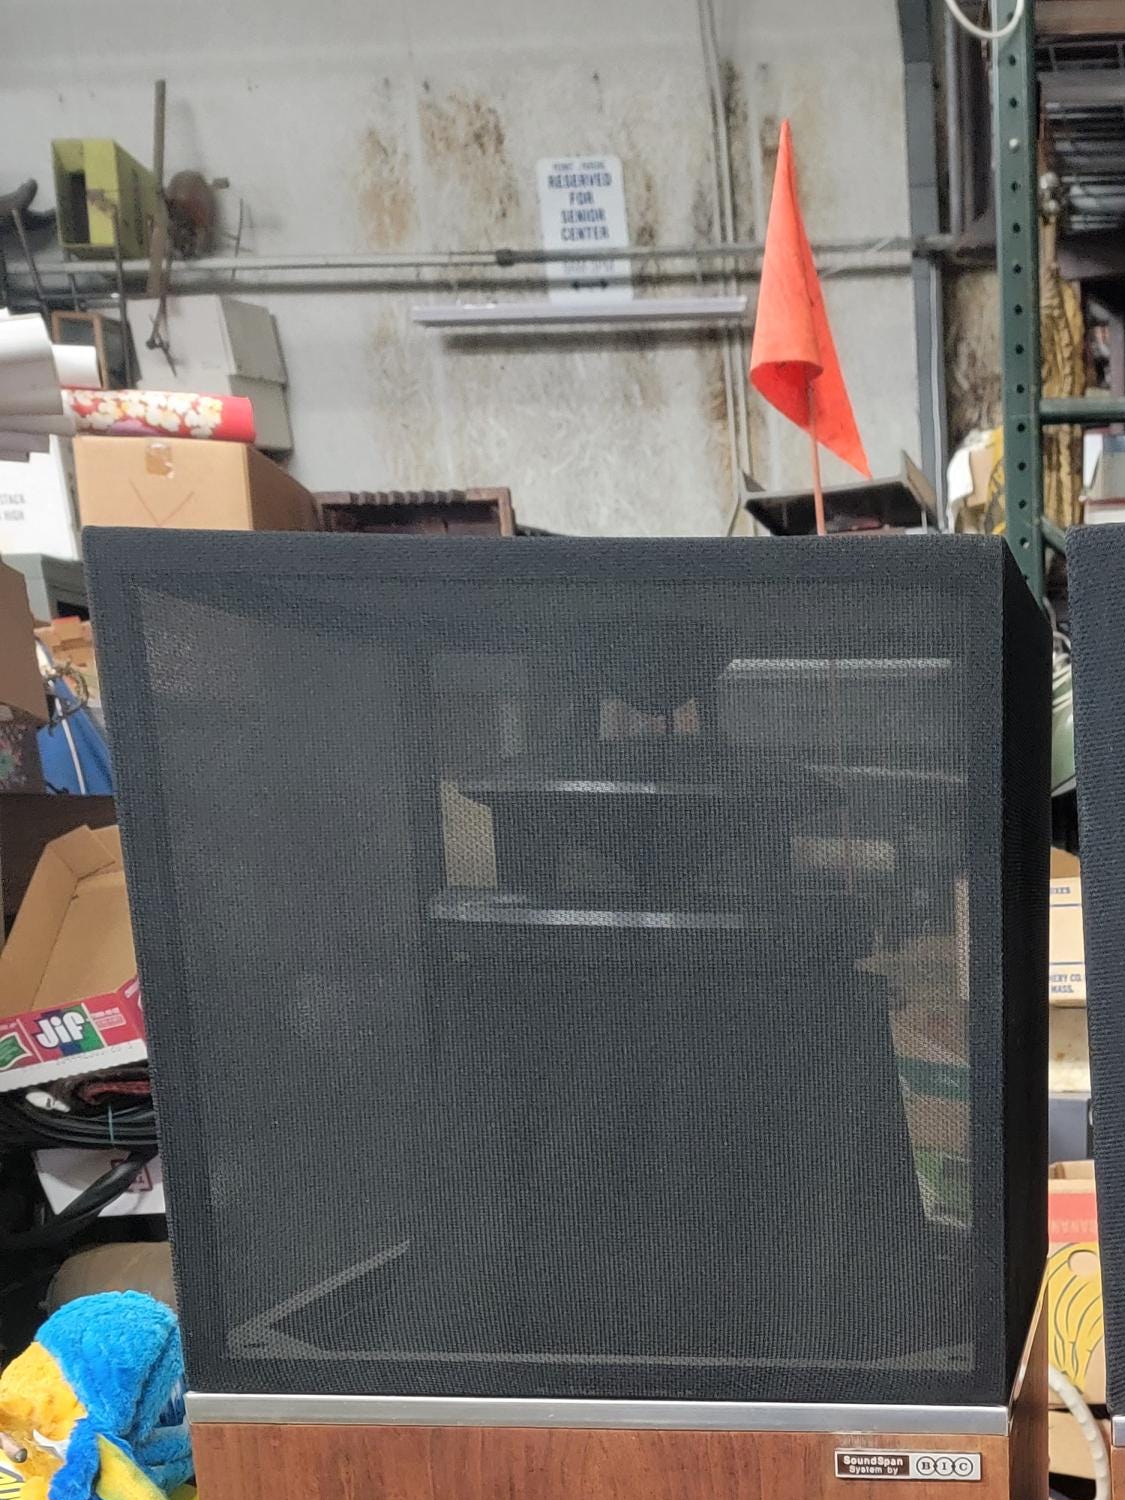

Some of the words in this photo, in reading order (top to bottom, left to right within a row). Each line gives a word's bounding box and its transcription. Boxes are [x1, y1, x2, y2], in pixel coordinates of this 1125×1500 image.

[548, 172, 612, 188] RESERVED
[569, 191, 594, 205] FOR
[561, 208, 606, 224] SENIOR
[561, 226, 609, 241] CENTER
[36, 1011, 85, 1048] Jif
[849, 1466, 882, 1475] System
[887, 1466, 899, 1476] by
[919, 1459, 971, 1474] BIC
